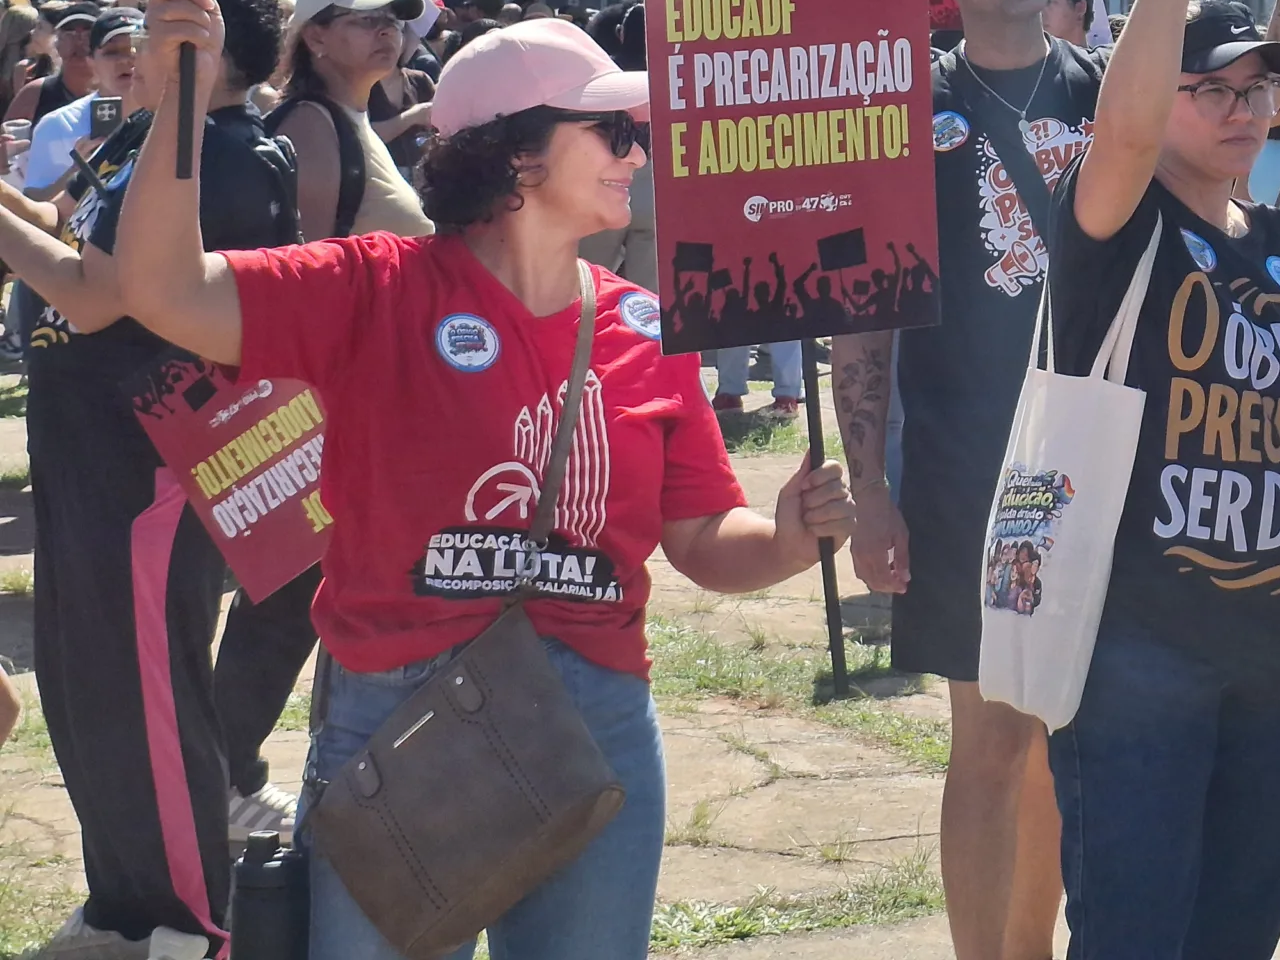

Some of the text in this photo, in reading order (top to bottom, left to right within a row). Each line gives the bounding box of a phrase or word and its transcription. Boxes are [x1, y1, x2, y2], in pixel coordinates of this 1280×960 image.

[668, 29, 912, 110] É PRECARIZAÇÃO
[670, 122, 690, 178] E
[698, 104, 910, 176] ADOECIMENTO!
[1168, 271, 1220, 371] O
[191, 389, 323, 500] ADOECIMENTO!
[302, 488, 334, 533] DF
[1153, 463, 1252, 553] SER
[425, 549, 597, 583] NA LUTA!
[536, 581, 594, 597] SALARIAL
